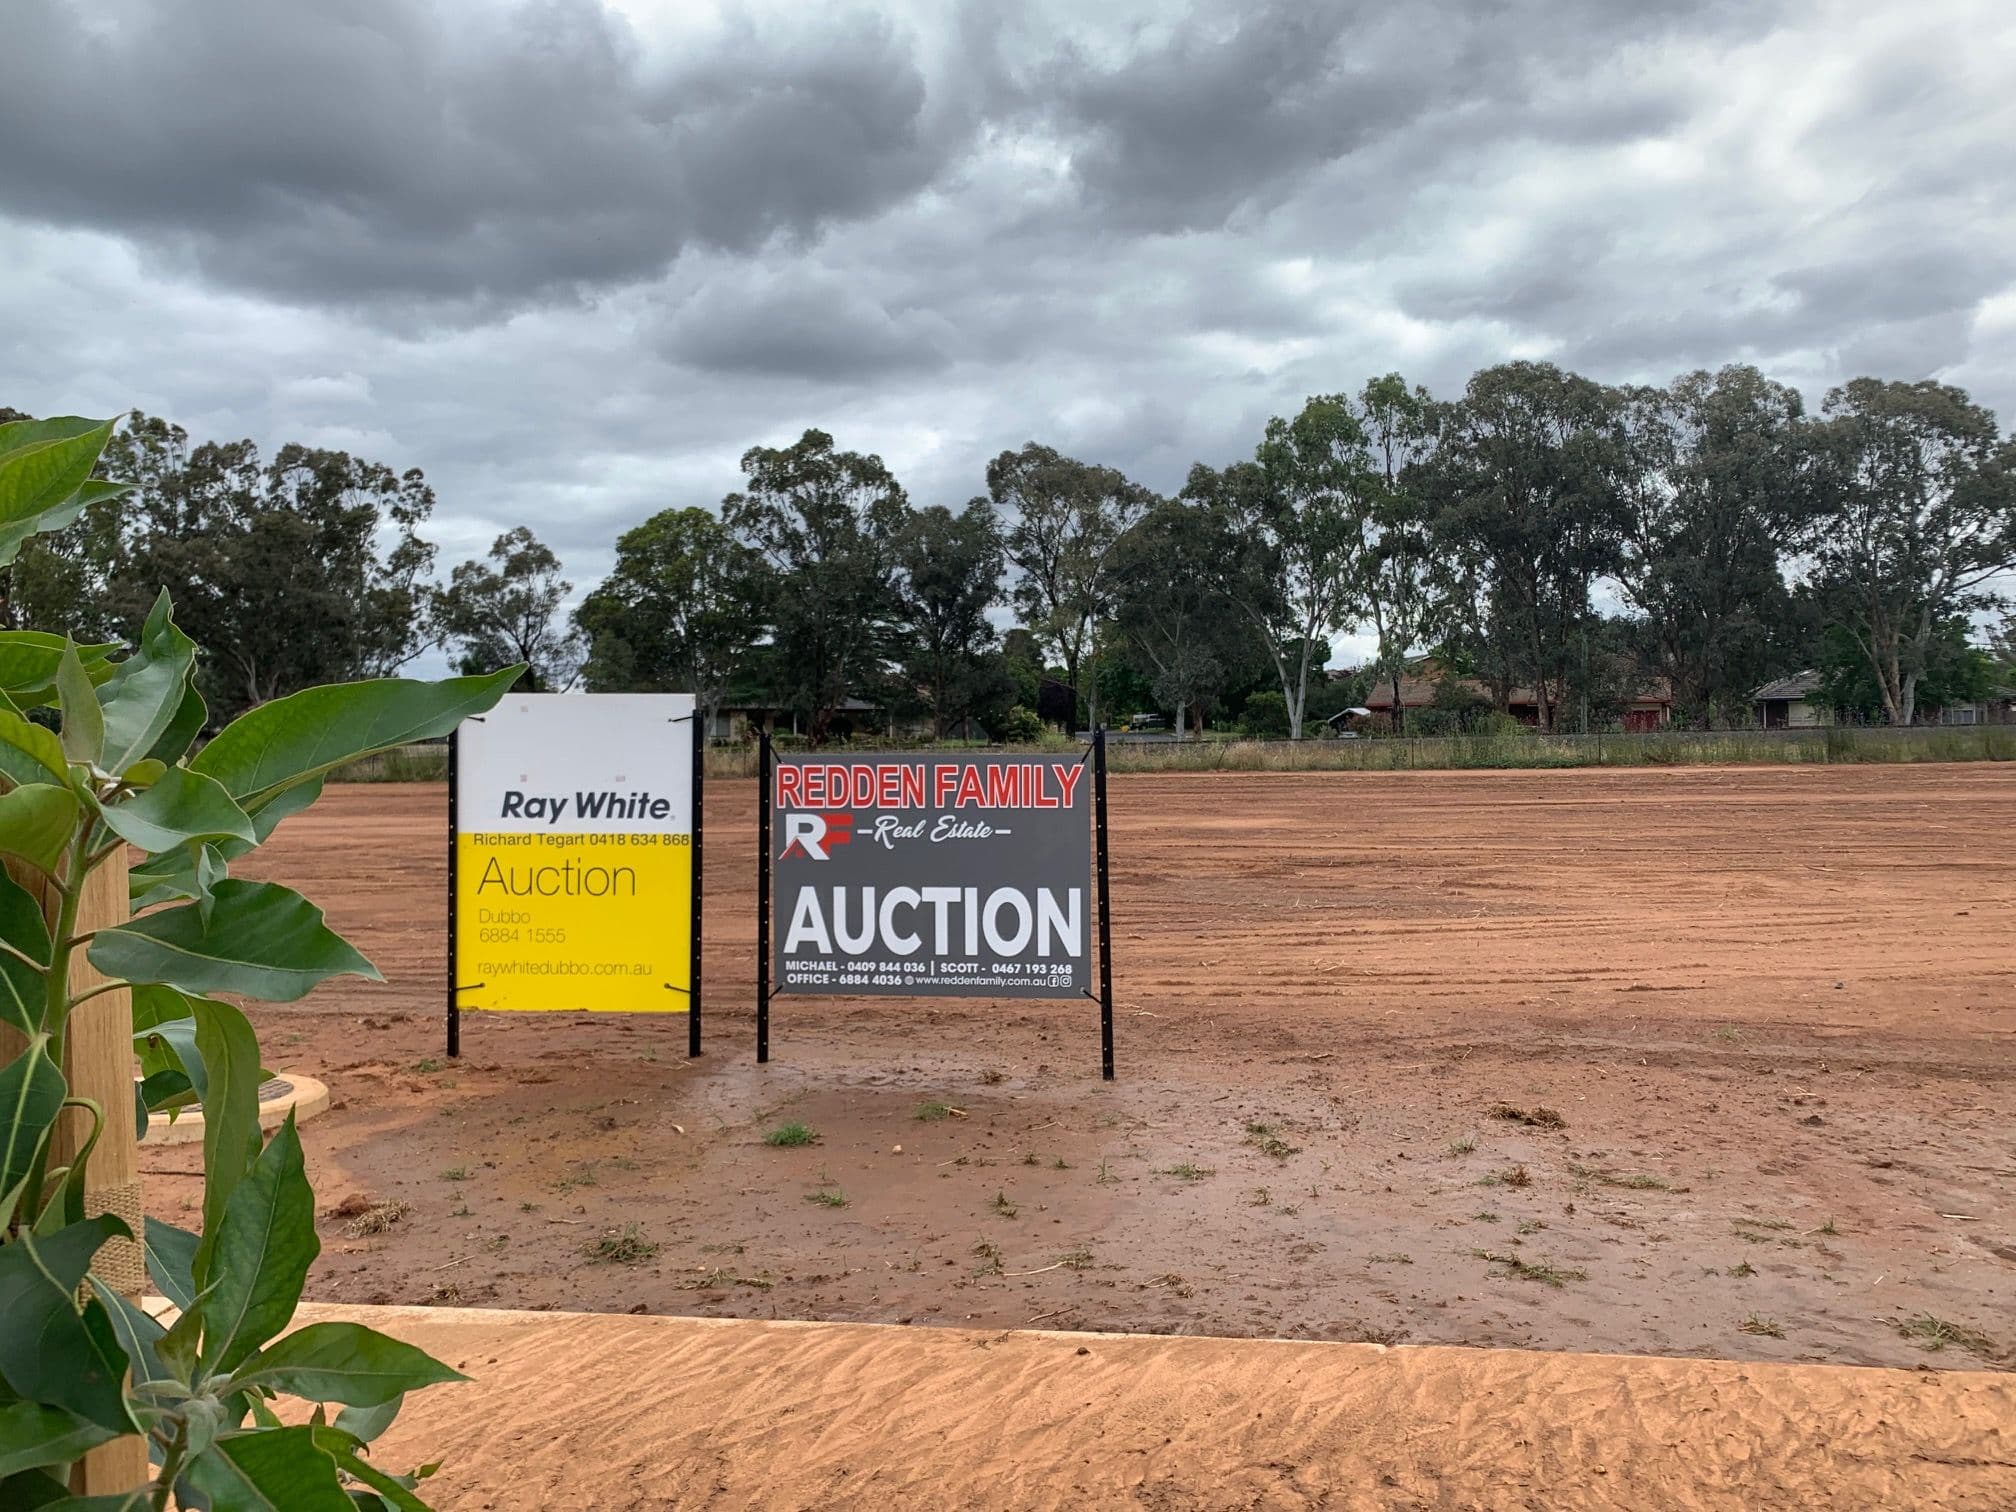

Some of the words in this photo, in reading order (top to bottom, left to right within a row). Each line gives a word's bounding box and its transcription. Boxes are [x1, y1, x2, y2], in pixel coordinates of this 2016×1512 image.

[776, 764, 926, 809] REDDEN
[934, 764, 1085, 809] FAMILY
[501, 791, 568, 824] Ray
[575, 791, 671, 820] White
[473, 833, 532, 846] Richard
[536, 833, 584, 848] Tegart
[589, 834, 626, 846] 0418
[630, 834, 658, 846] 634
[662, 834, 689, 846] 868
[873, 815, 927, 850] Real
[929, 815, 993, 843] Estate
[477, 856, 636, 896] Auction
[479, 908, 531, 924] Dubbo
[783, 886, 1082, 957] AUCTION
[479, 928, 519, 943] 6884
[527, 928, 566, 943] 1555
[477, 960, 652, 978] raywhitedubbo.com.au
[785, 960, 838, 972] MICHAEL
[847, 961, 876, 973] 0409
[878, 961, 901, 973] 844
[903, 962, 926, 973] 036
[940, 963, 979, 973] SCOTT
[992, 963, 1021, 974] 0467
[1025, 964, 1047, 974] 193
[1050, 964, 1073, 975] 268
[786, 973, 830, 985] OFFICE
[839, 974, 869, 985] 6884
[871, 975, 902, 986] 4036
[915, 975, 1047, 987] www.reddenfamily.com.au
